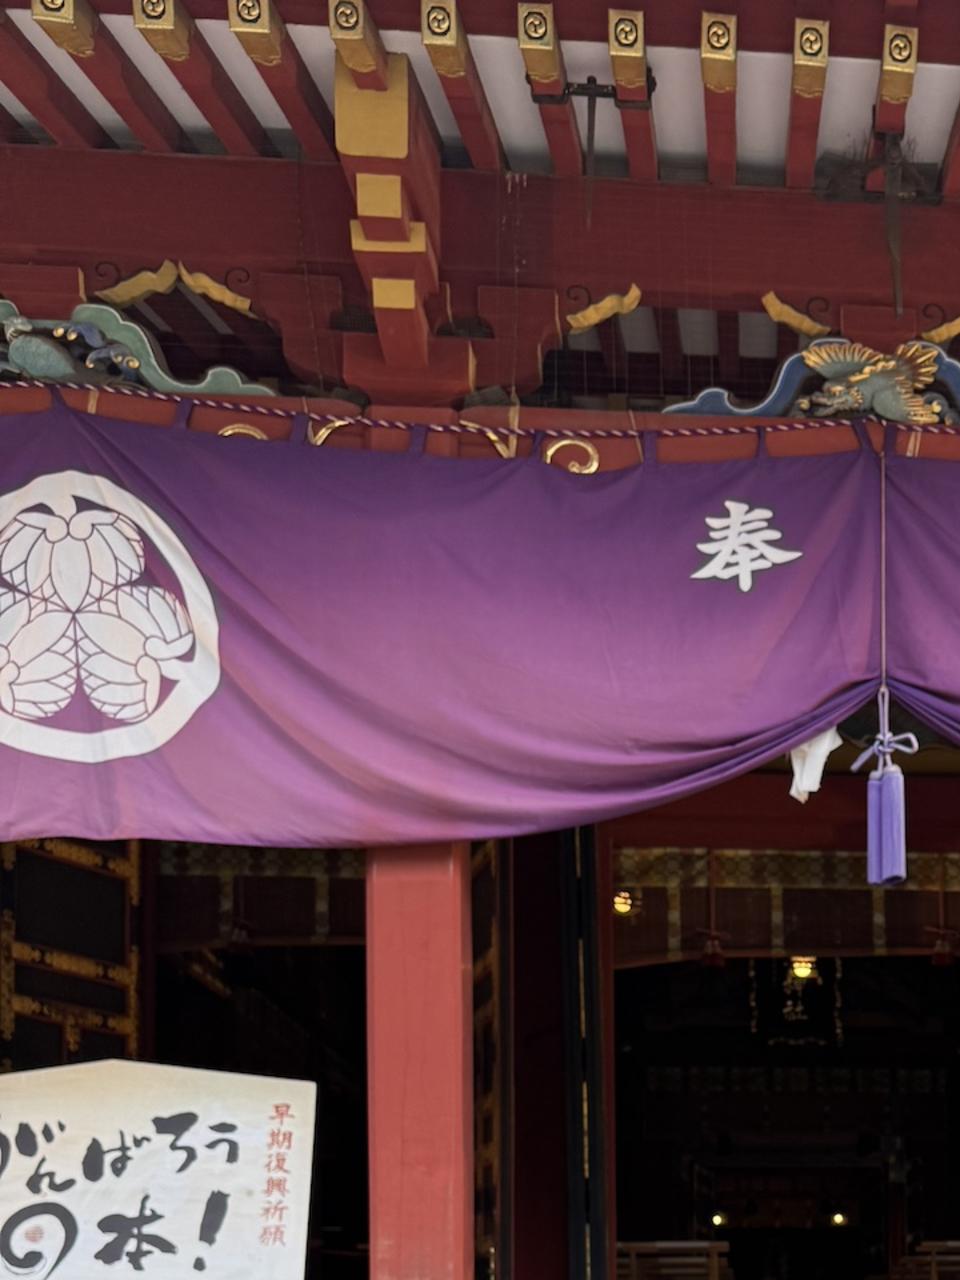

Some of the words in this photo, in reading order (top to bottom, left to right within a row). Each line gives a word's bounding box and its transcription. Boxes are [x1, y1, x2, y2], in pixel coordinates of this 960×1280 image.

[690, 500, 803, 592] 奉
[259, 1103, 296, 1247] 早期復興祈願
